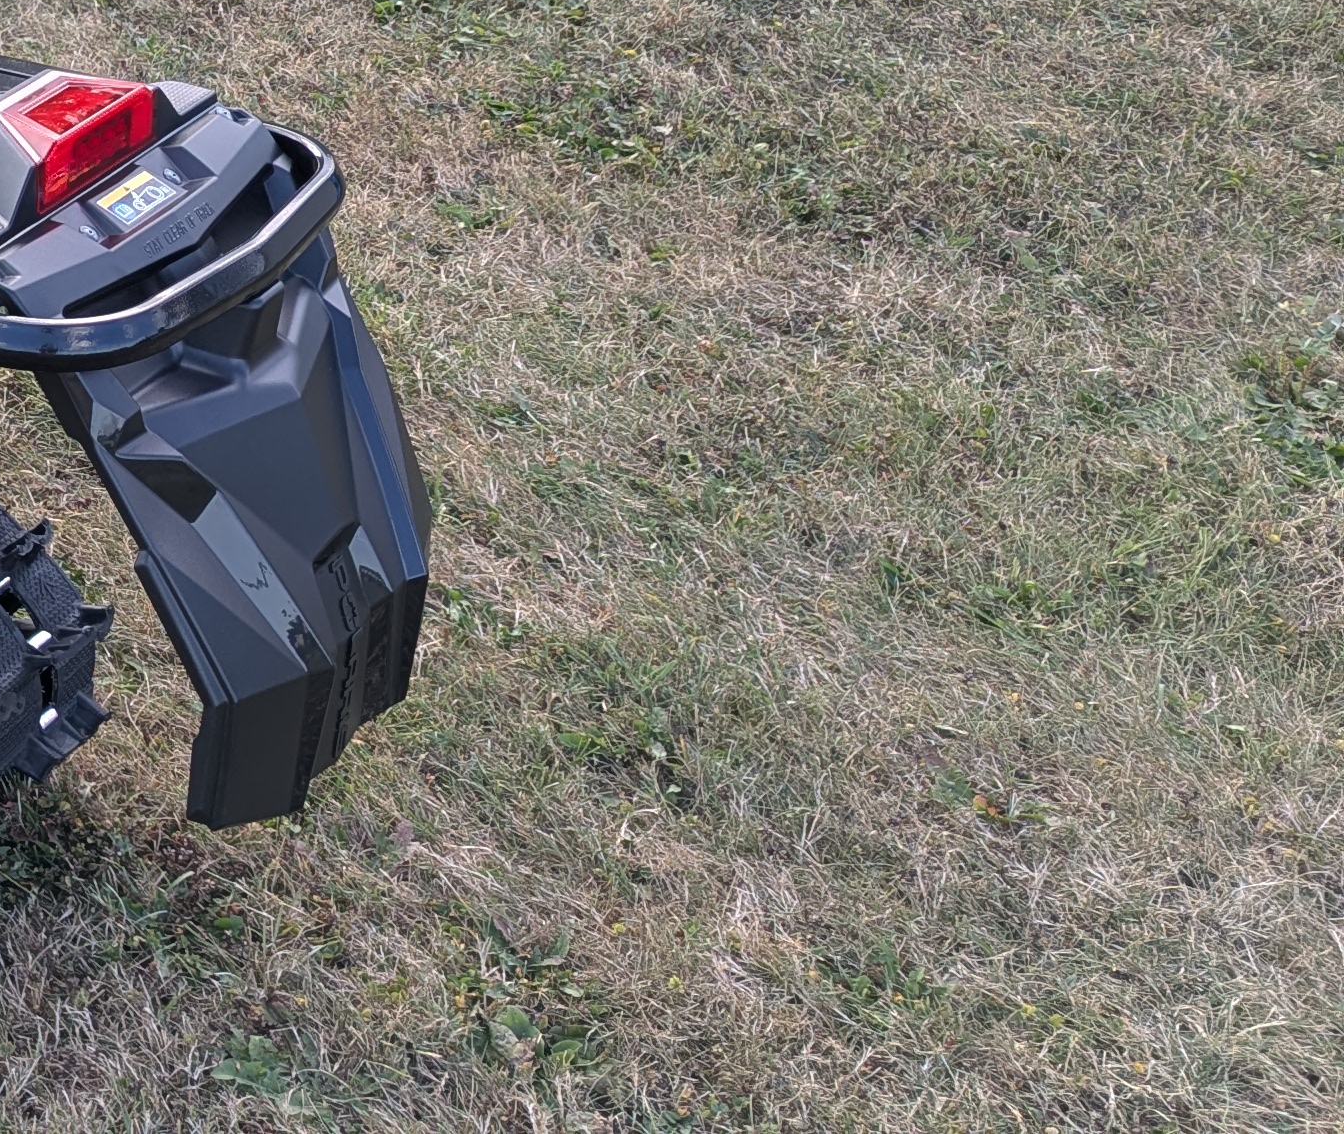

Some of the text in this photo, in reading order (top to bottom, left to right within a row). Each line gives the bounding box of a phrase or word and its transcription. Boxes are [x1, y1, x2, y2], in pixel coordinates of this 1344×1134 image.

[143, 202, 215, 259] STAY CLEAR OF TRACK
